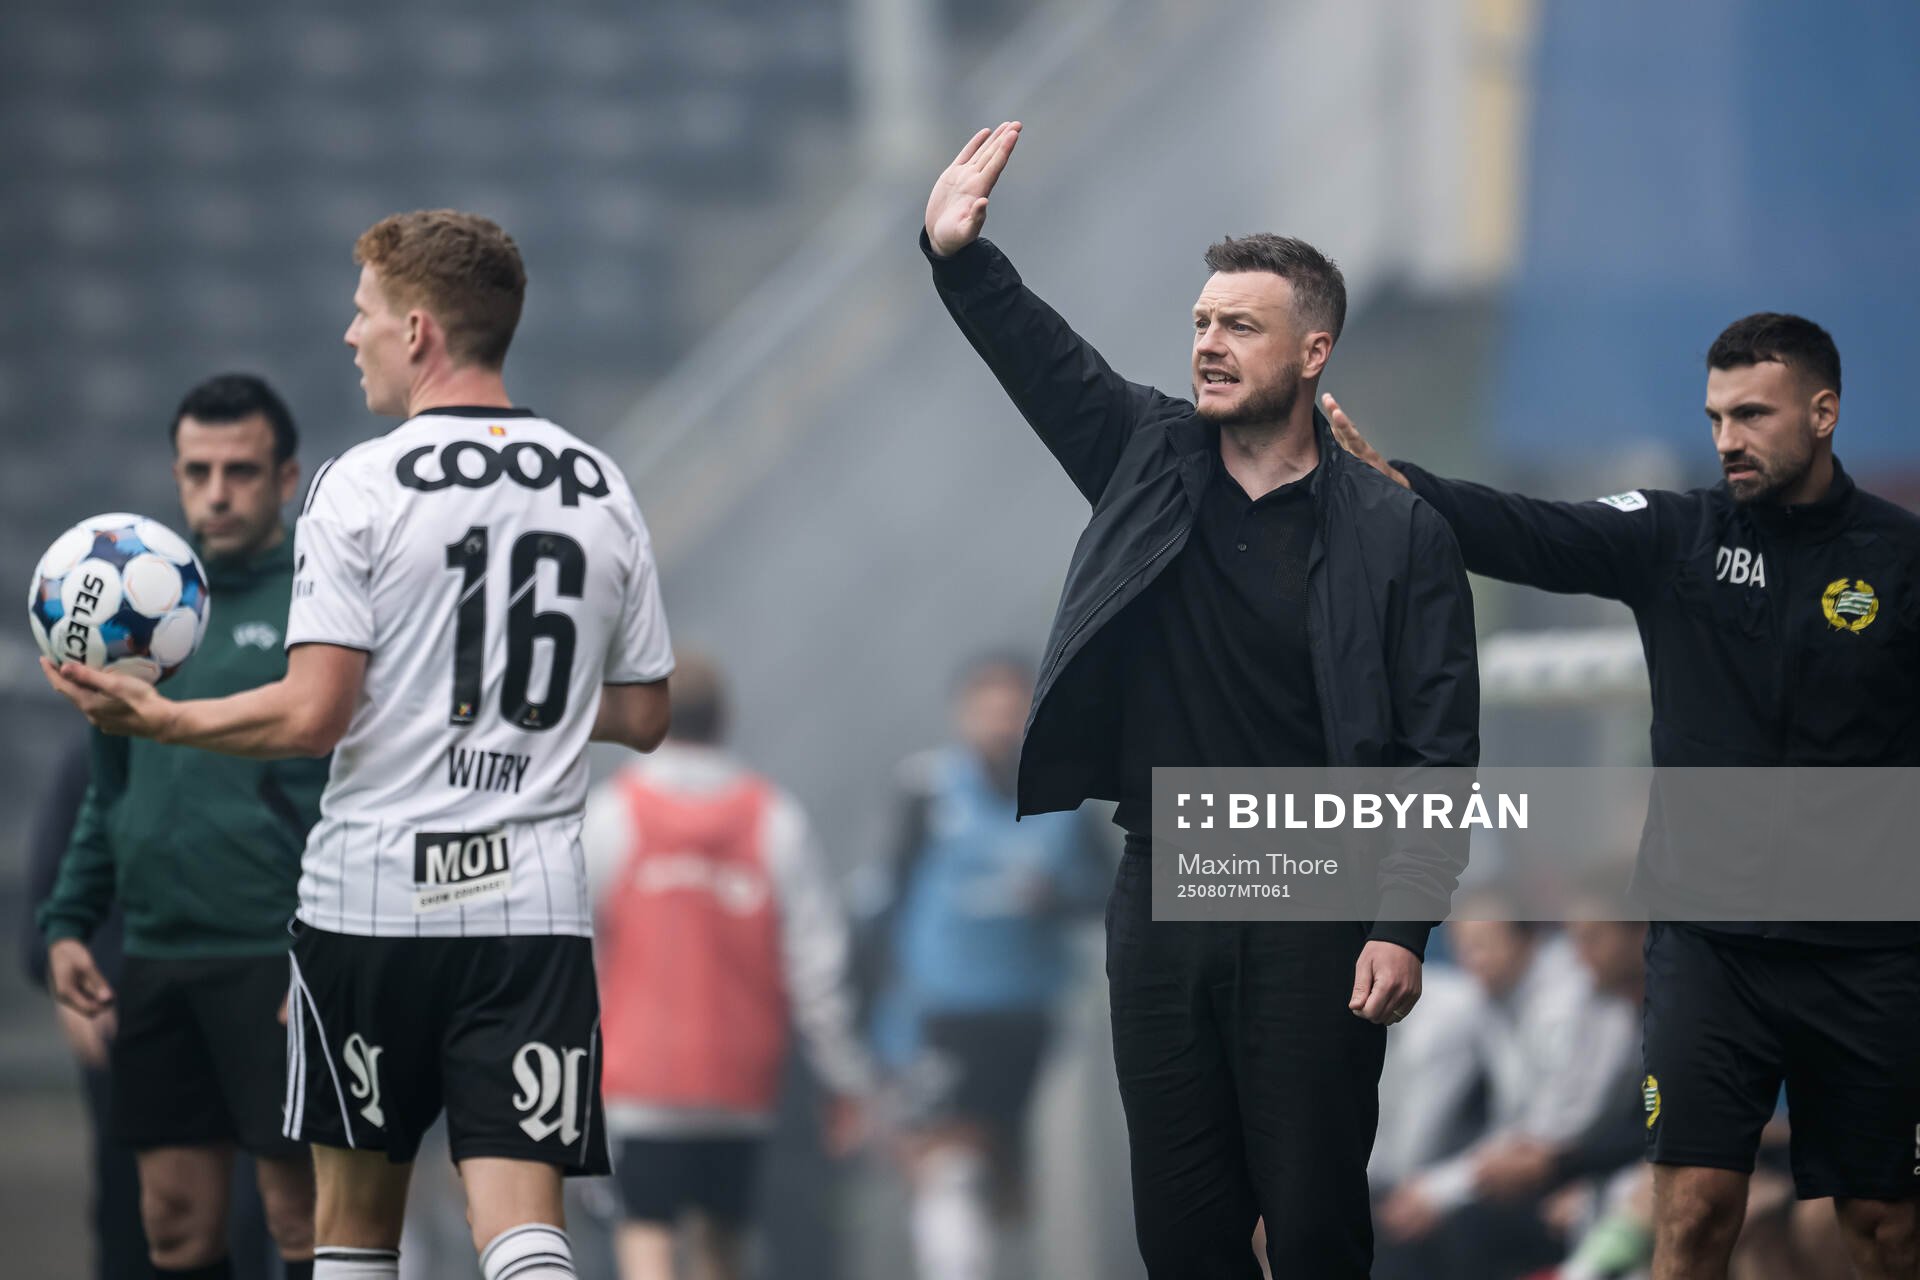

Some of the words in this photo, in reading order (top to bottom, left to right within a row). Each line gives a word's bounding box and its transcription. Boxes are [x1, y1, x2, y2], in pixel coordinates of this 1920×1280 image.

[396, 440, 611, 507] coop
[65, 573, 105, 665] SELECT
[446, 526, 587, 732] 16
[449, 746, 531, 794] WITRY
[425, 832, 507, 885] MOT
